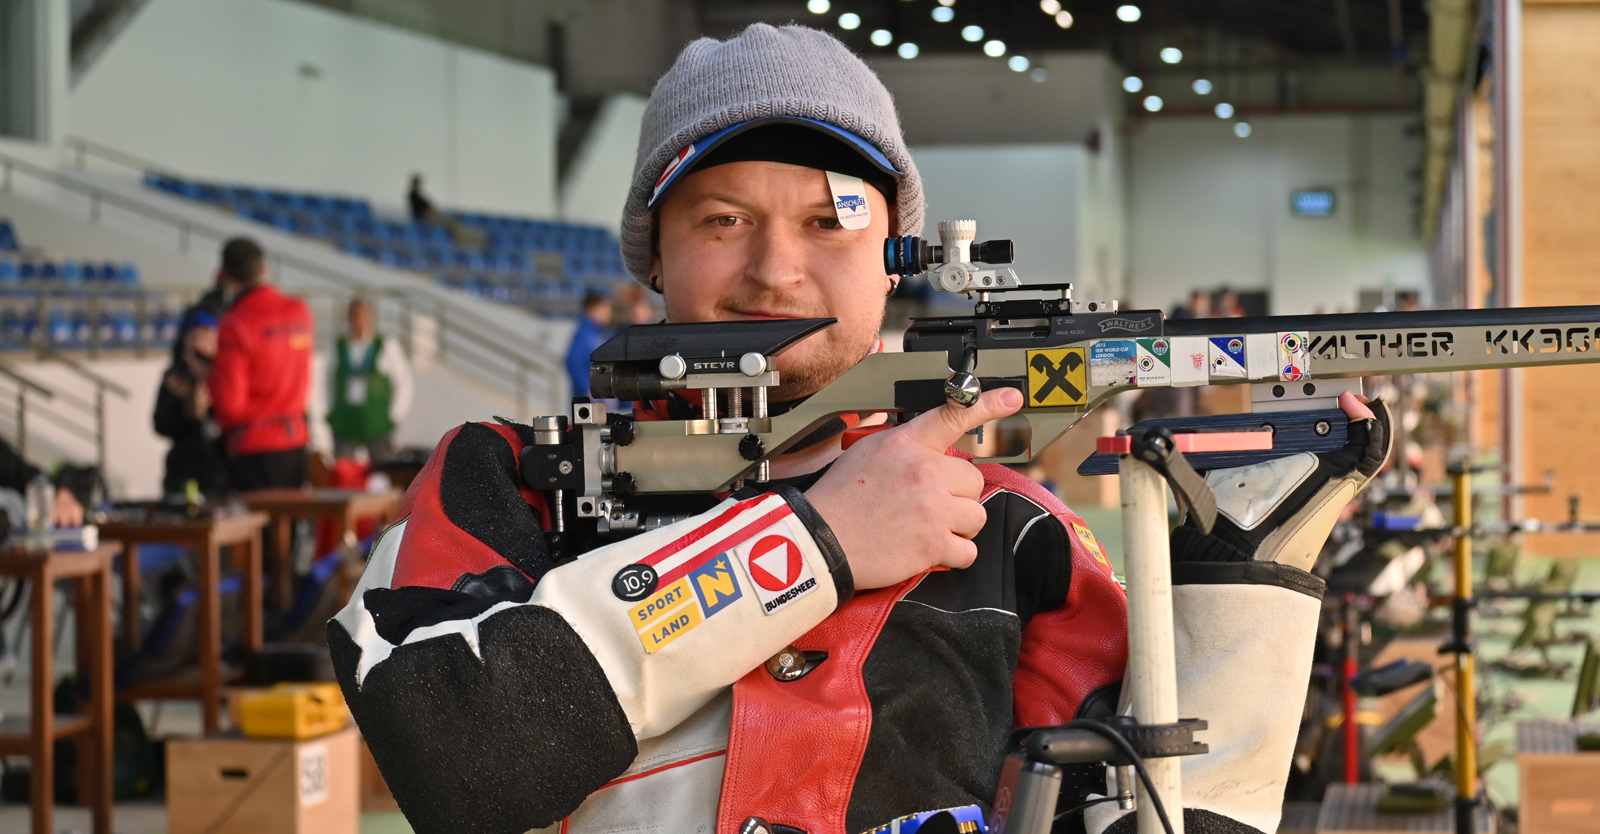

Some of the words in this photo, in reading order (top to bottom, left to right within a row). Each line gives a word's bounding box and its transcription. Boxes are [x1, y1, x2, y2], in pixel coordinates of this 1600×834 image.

[1105, 319, 1147, 330] WALTHER
[693, 361, 735, 370] STEYR
[623, 570, 653, 592] 10.9
[637, 586, 683, 621] SPORT
[764, 577, 817, 612] BUNDESHEER
[652, 614, 690, 644] LAND
